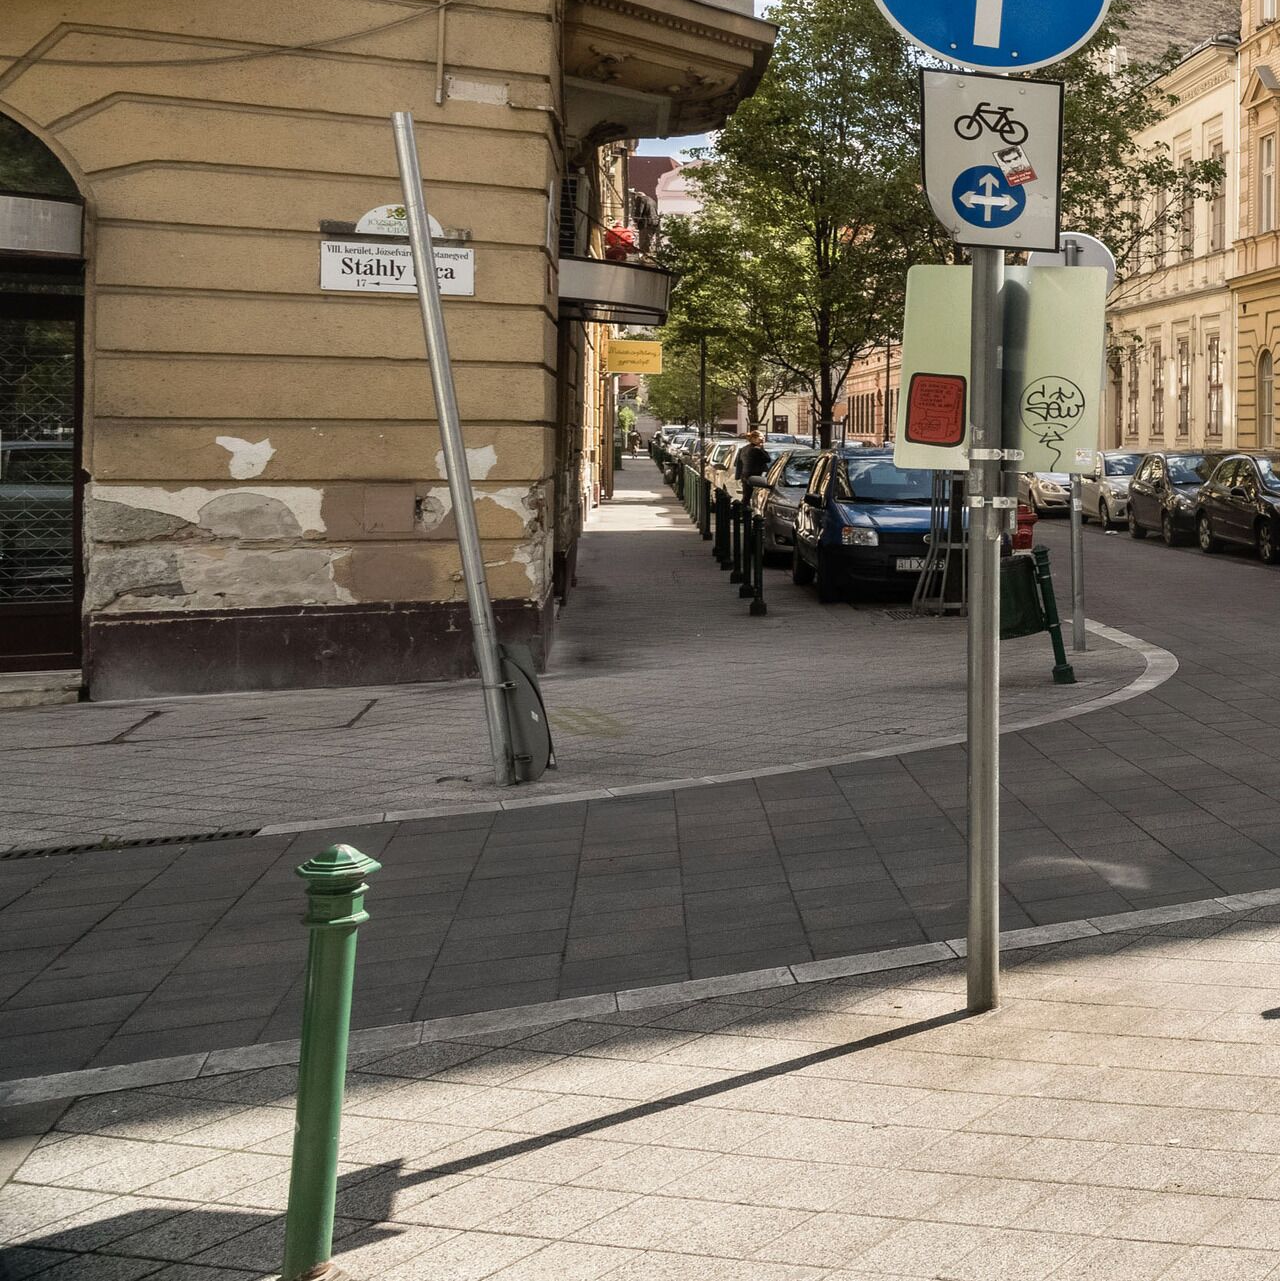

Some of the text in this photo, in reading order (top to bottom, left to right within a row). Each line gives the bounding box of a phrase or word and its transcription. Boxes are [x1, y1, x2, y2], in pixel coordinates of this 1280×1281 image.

[344, 245, 374, 256] kerület,
[375, 247, 413, 258] Józsefvár
[433, 251, 469, 261] otanegyed
[341, 257, 406, 280] Stáhly
[356, 278, 367, 287] 17
